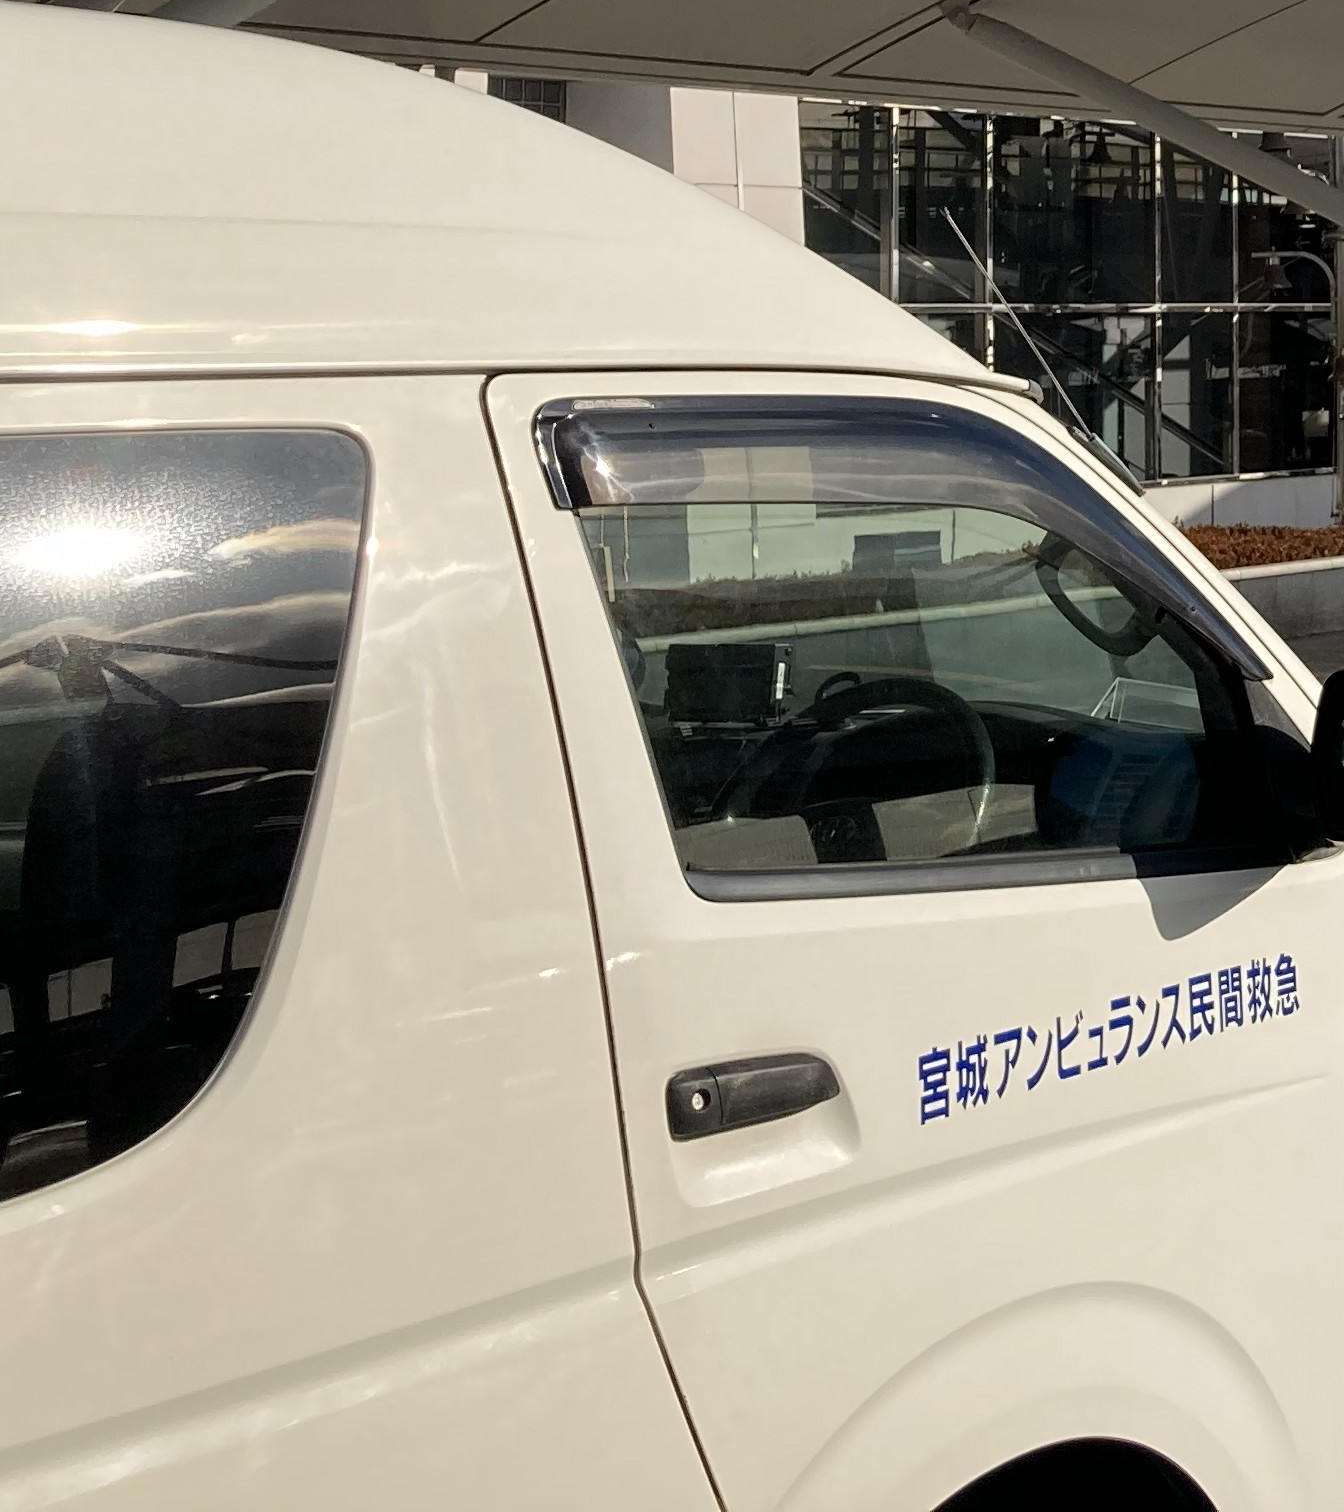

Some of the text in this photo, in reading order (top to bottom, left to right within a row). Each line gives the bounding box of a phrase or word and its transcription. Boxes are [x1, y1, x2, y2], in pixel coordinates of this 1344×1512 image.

[918, 952, 1300, 1125] 宮城アンビュランス民間救急
